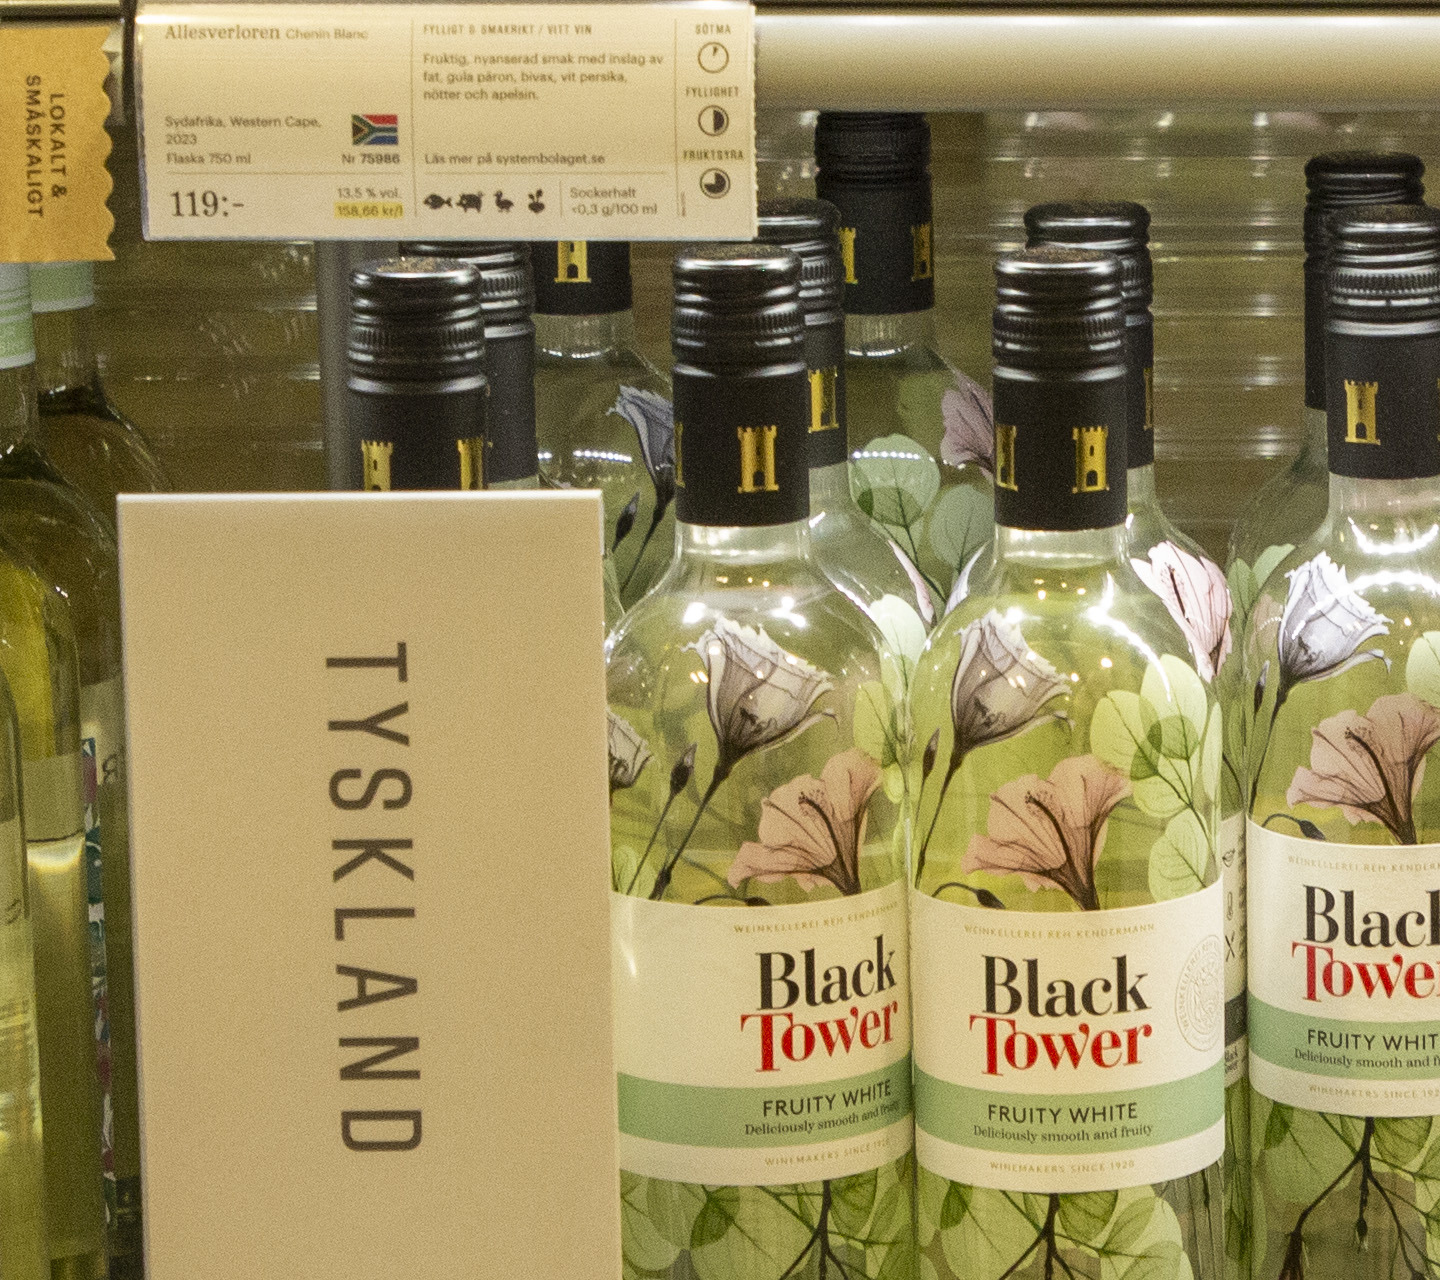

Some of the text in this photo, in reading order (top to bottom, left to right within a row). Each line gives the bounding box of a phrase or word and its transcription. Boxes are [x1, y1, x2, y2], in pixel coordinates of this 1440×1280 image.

[165, 25, 280, 40] Allesverloren
[24, 74, 44, 220] SMÅSKALIGT
[50, 92, 66, 174] LOKALT
[326, 642, 422, 1152] TYSKLAND
[755, 934, 898, 1011] Black
[982, 954, 1152, 1018] Black
[740, 1000, 899, 1074] Tower
[969, 1014, 1153, 1076] Tower
[1308, 1030, 1376, 1050] FRUITY
[763, 1078, 892, 1118] FRUITY WHITE
[988, 1102, 1138, 1124] FRUITY WHITE
[974, 1124, 1038, 1144] Deliciously
[1041, 1128, 1090, 1143] smooth
[1094, 1126, 1118, 1141] and
